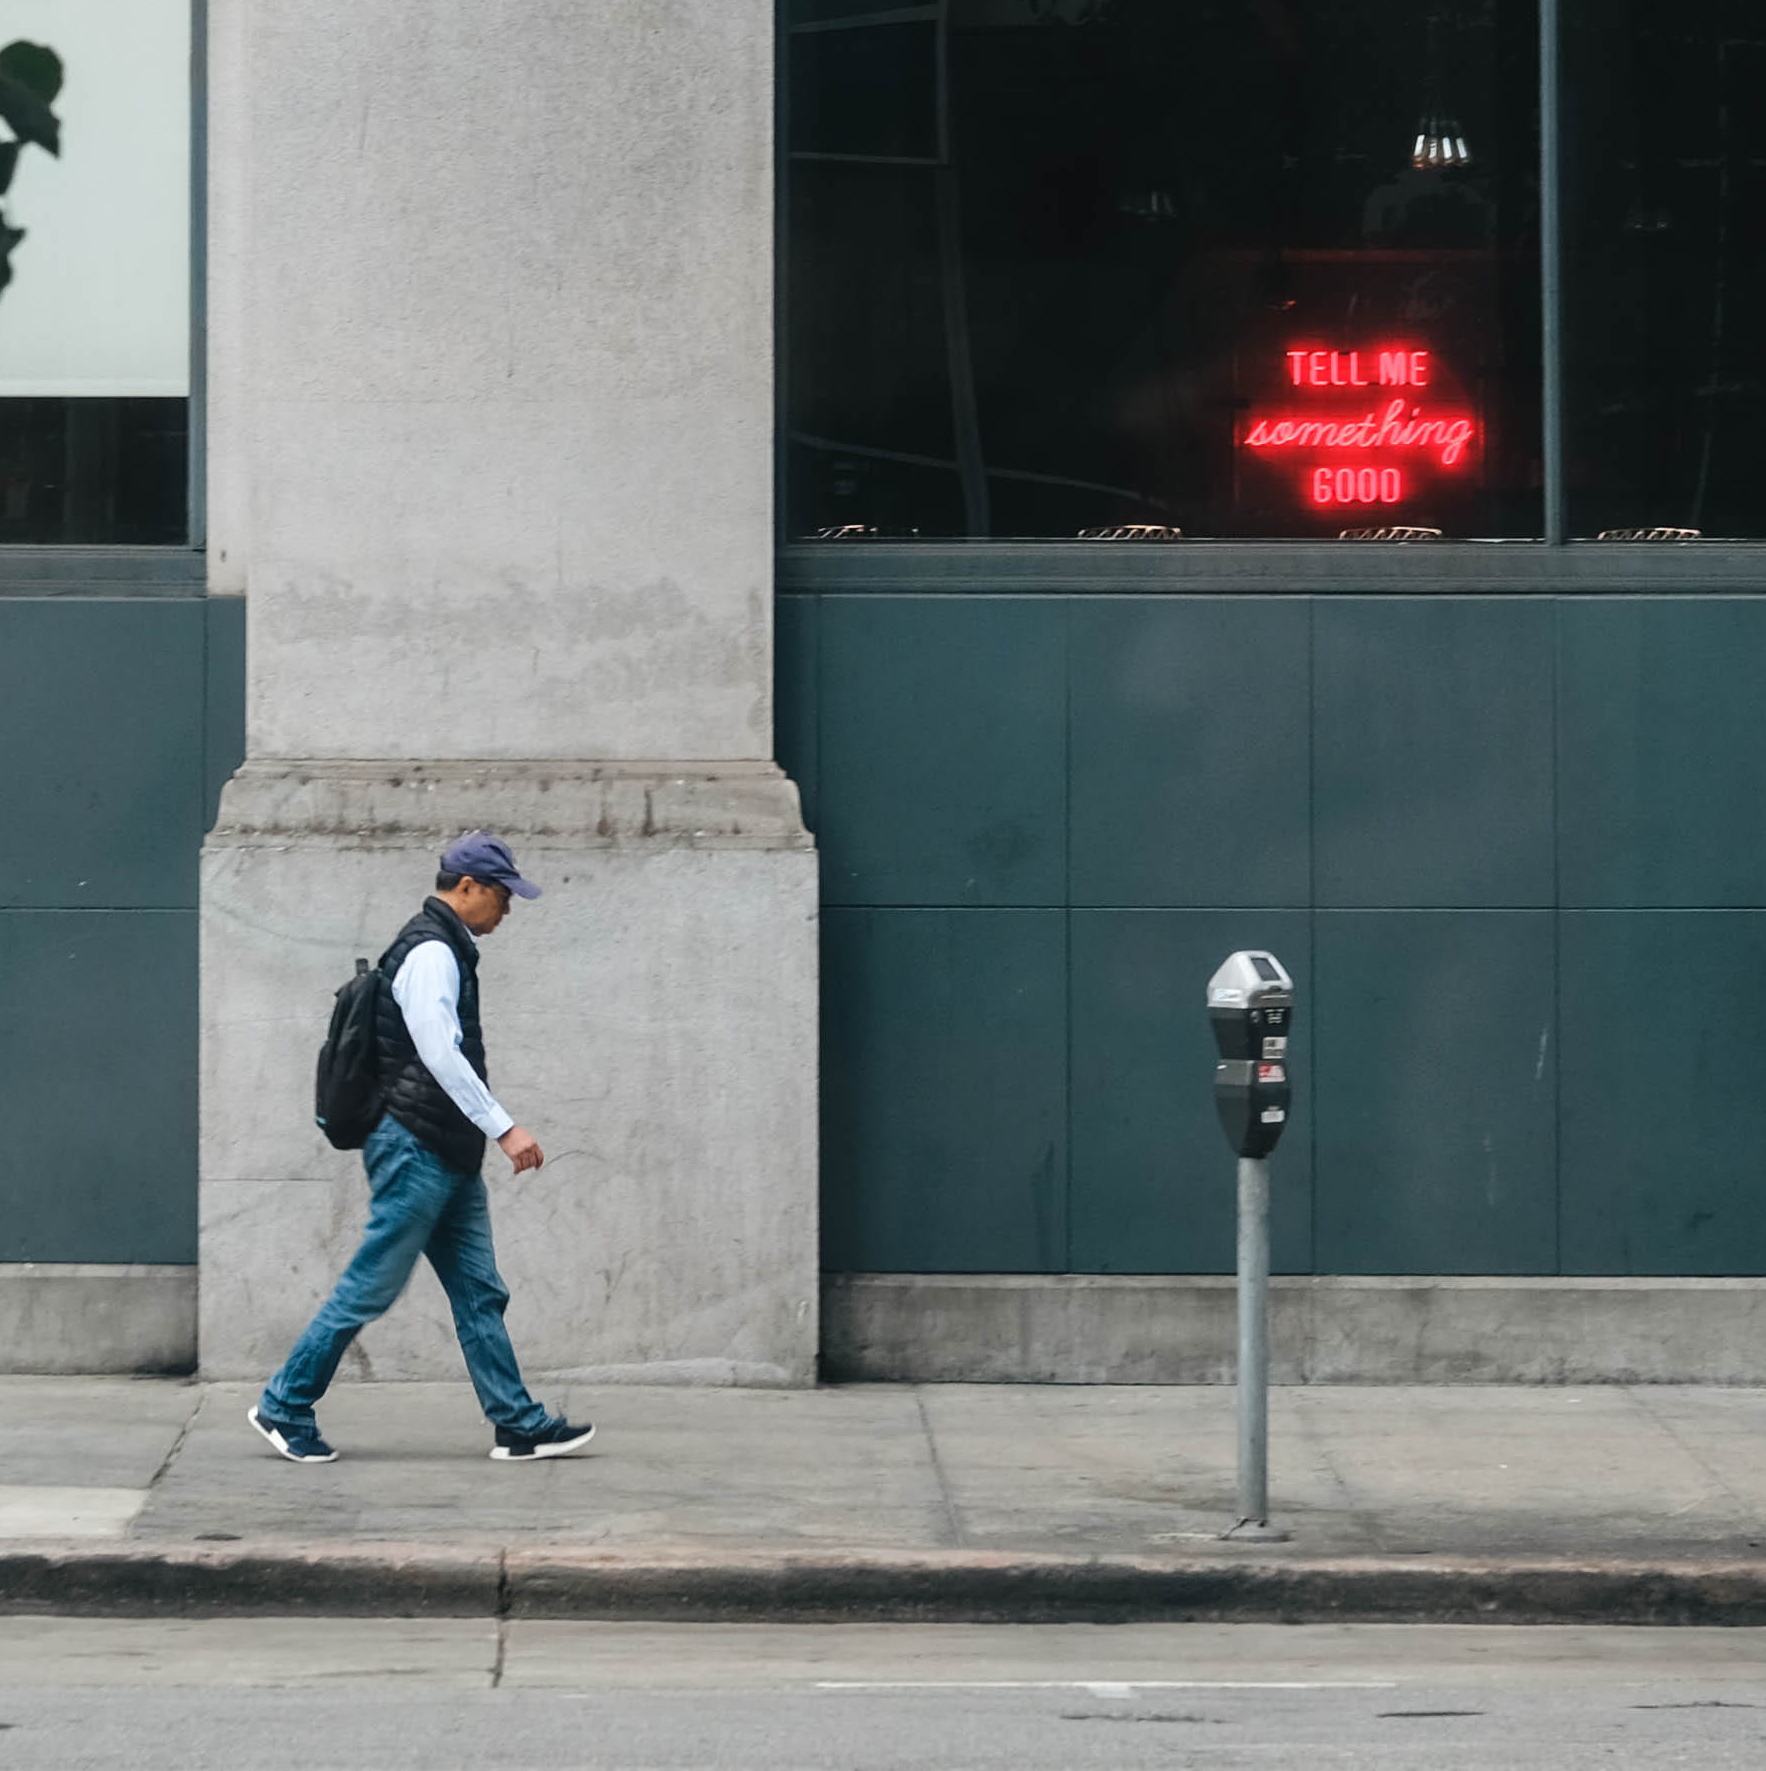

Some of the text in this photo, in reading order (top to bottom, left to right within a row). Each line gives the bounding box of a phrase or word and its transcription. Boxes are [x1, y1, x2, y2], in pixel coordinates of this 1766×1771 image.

[1286, 350, 1429, 386] TELL ME
[1244, 398, 1473, 465] something
[1313, 467, 1402, 504] GOOD
